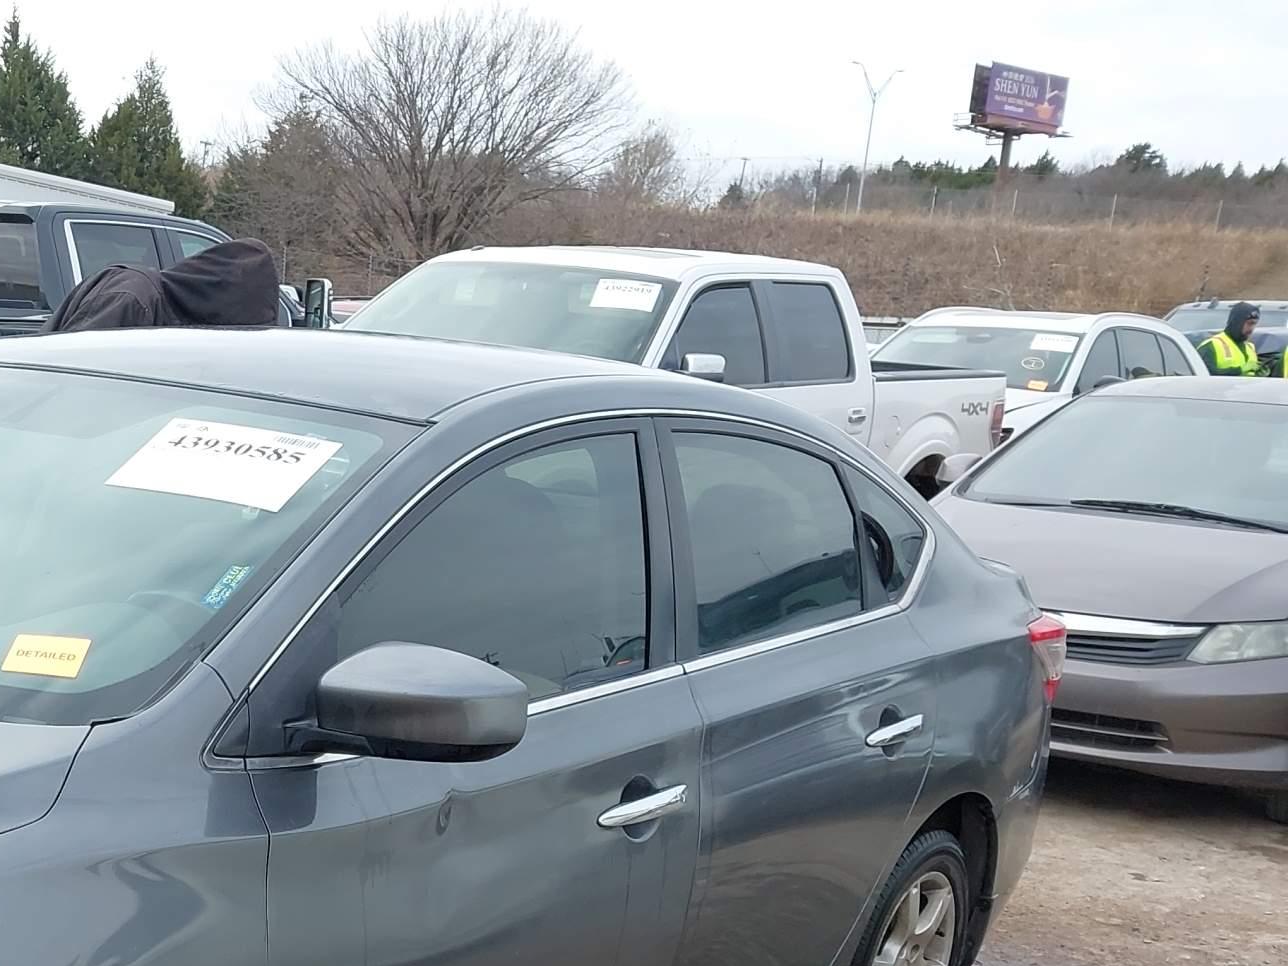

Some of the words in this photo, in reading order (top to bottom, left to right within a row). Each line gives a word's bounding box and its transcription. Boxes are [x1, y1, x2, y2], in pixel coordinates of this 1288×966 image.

[994, 78, 1019, 95] SHEN
[1020, 84, 1039, 98] YUN
[168, 434, 307, 464] 43930585
[16, 650, 77, 662] DETAILED
